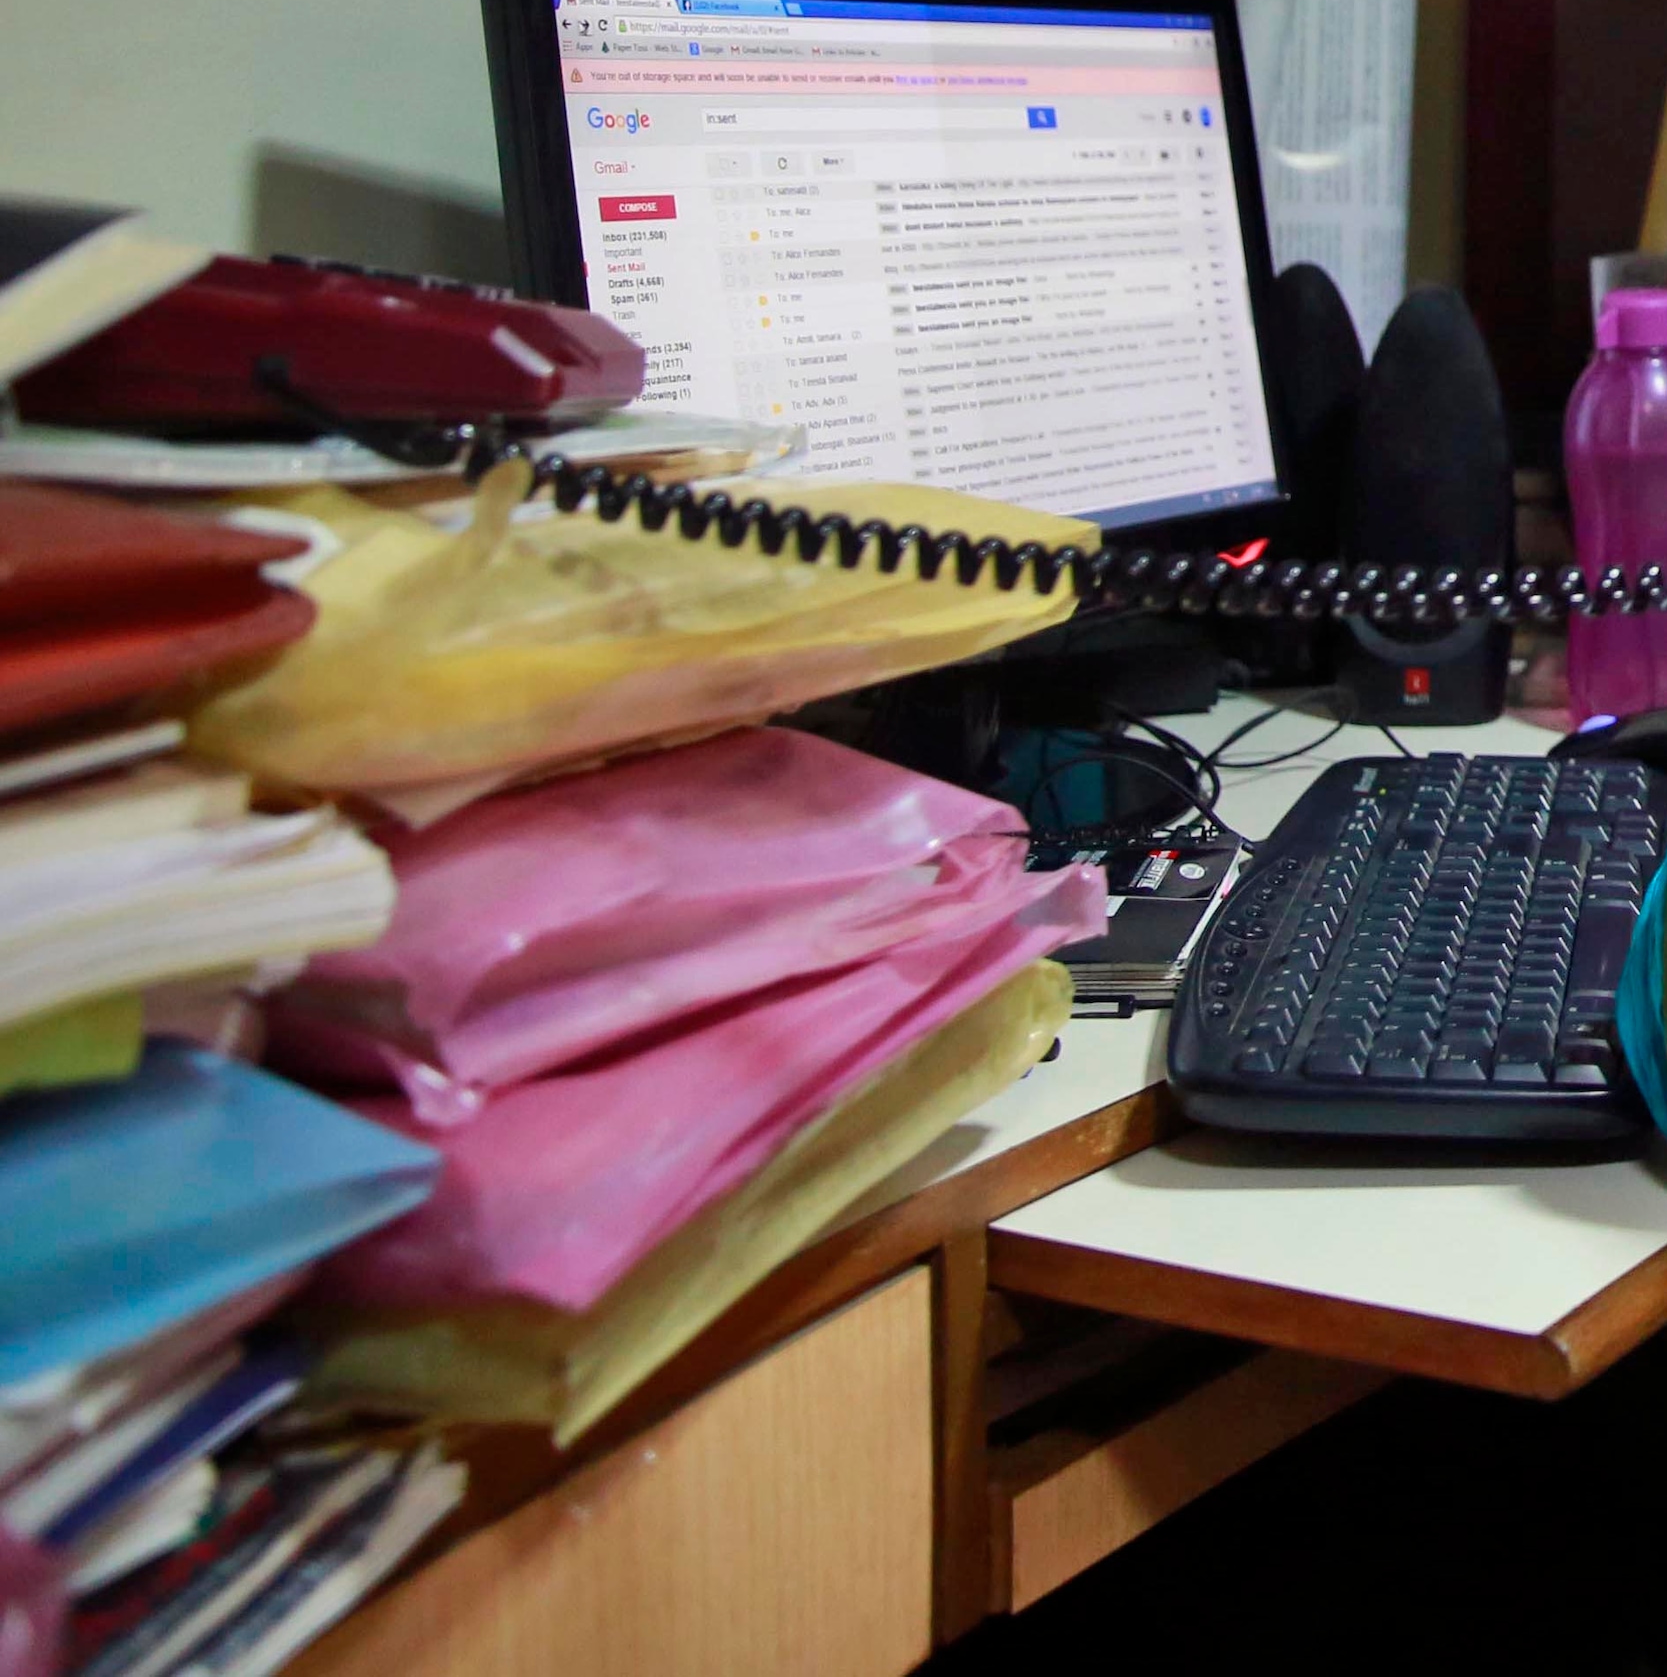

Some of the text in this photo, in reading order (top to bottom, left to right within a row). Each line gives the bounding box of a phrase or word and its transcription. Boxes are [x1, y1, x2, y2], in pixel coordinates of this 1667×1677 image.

[587, 107, 651, 134] Google
[594, 161, 628, 174] Gmail
[618, 202, 658, 213] COMPOSE
[602, 231, 628, 242] Inbox
[604, 246, 643, 259] Important
[607, 262, 646, 273] Sent Mail
[608, 278, 635, 289] Drafts
[611, 294, 635, 306] Spam
